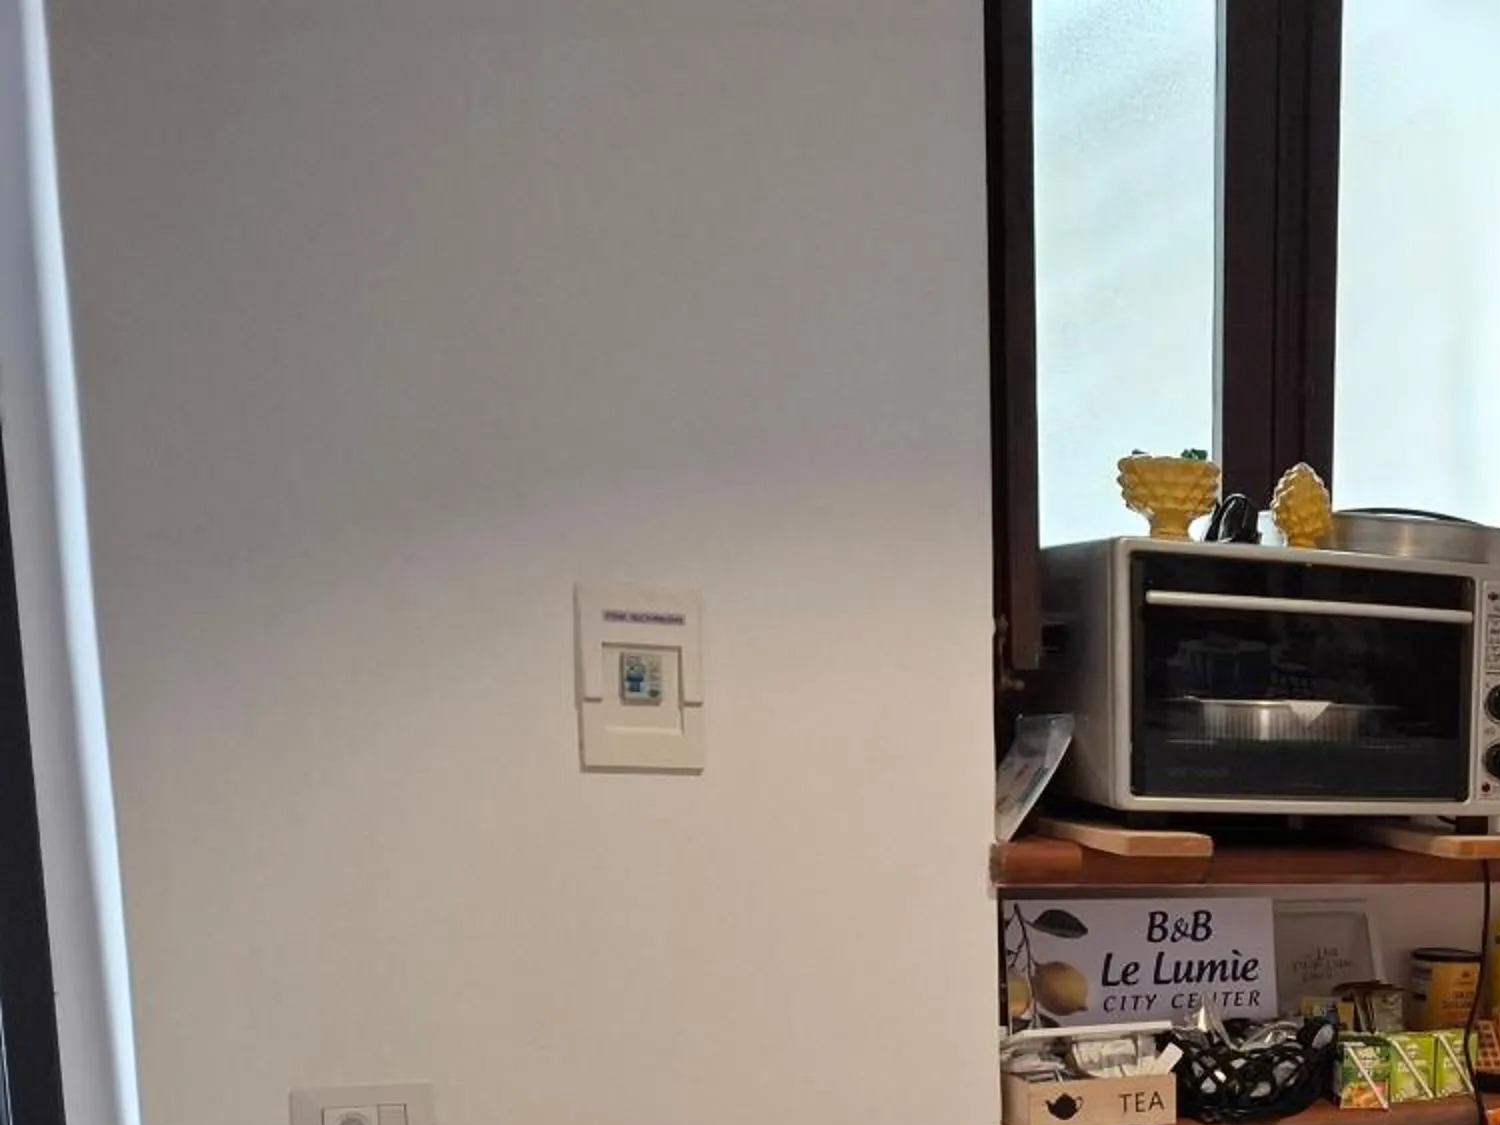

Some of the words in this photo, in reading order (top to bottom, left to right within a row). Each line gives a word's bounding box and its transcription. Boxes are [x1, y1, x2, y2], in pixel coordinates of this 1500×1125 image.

[1146, 909, 1213, 943] B&B
[1101, 952, 1140, 987] Le
[1103, 994, 1157, 1013] CITY
[1119, 1090, 1165, 1113] TEA
